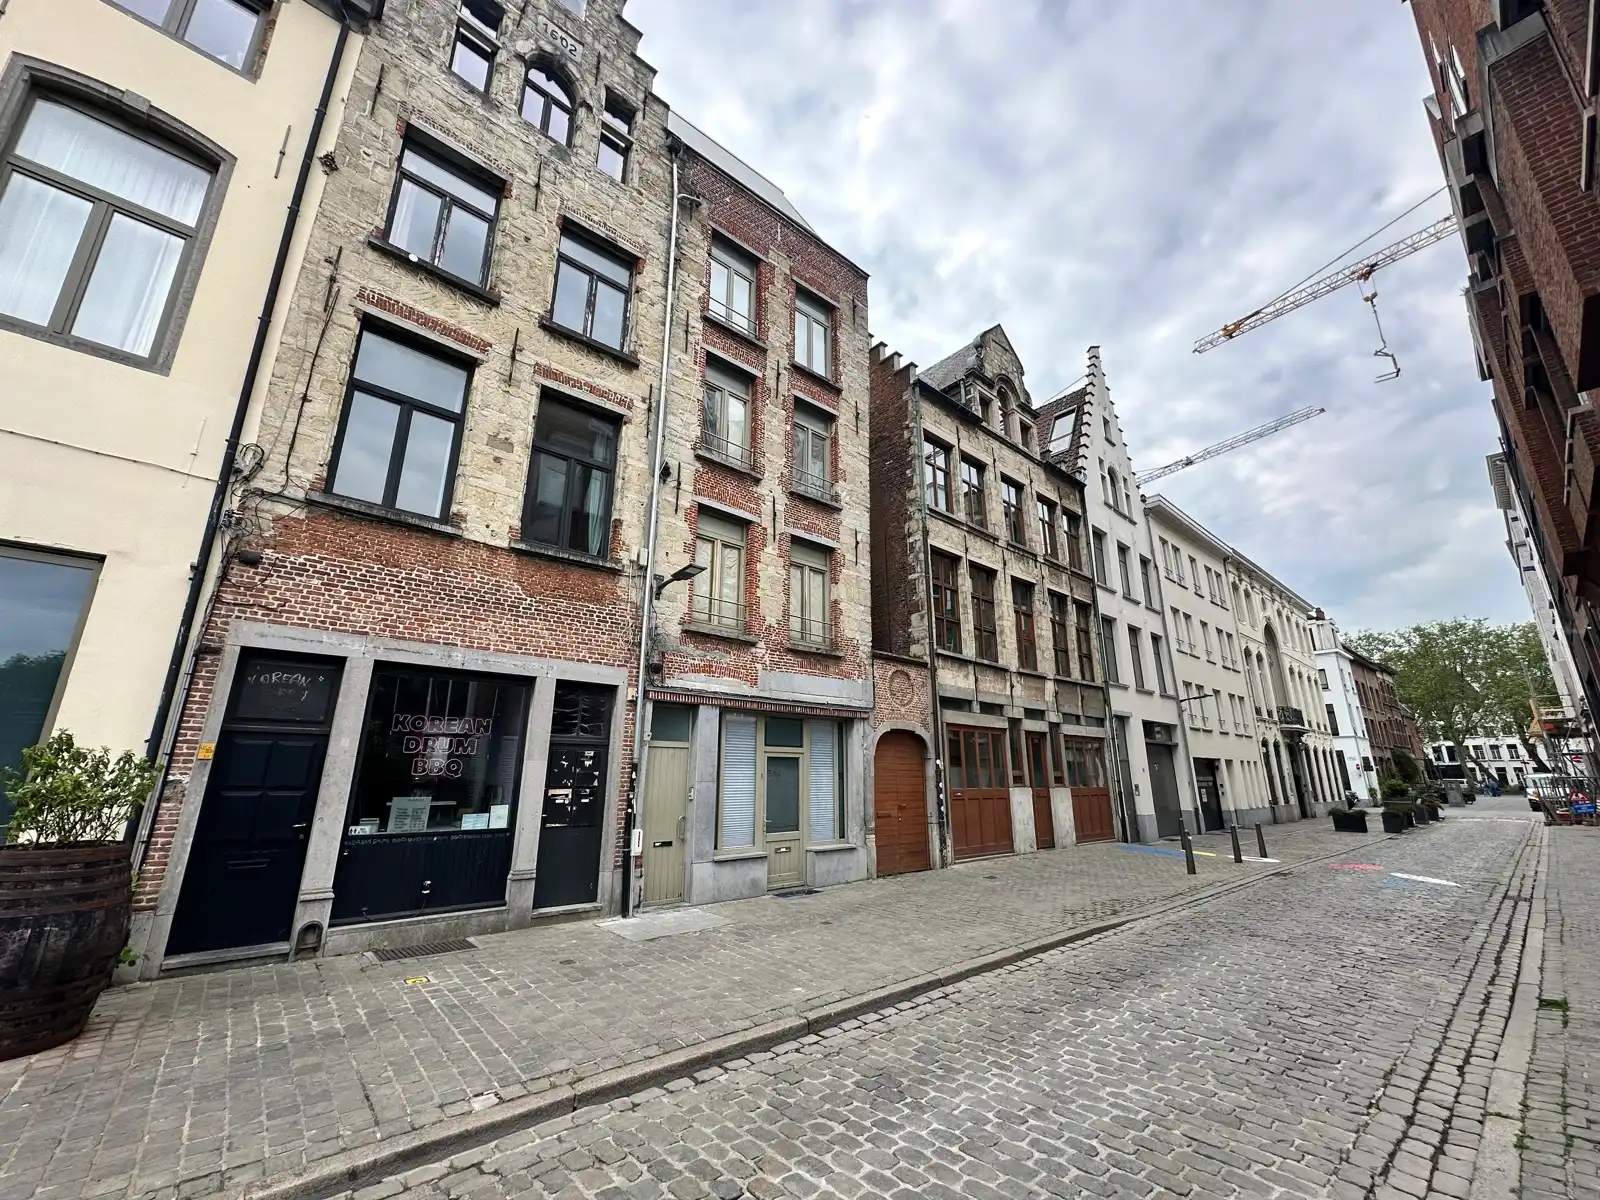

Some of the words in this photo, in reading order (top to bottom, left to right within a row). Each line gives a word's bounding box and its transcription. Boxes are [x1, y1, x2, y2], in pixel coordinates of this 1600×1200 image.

[543, 23, 577, 57] 1602
[391, 713, 492, 735] KOREAN
[402, 736, 478, 755] DRUM
[411, 758, 463, 778] BBQ
